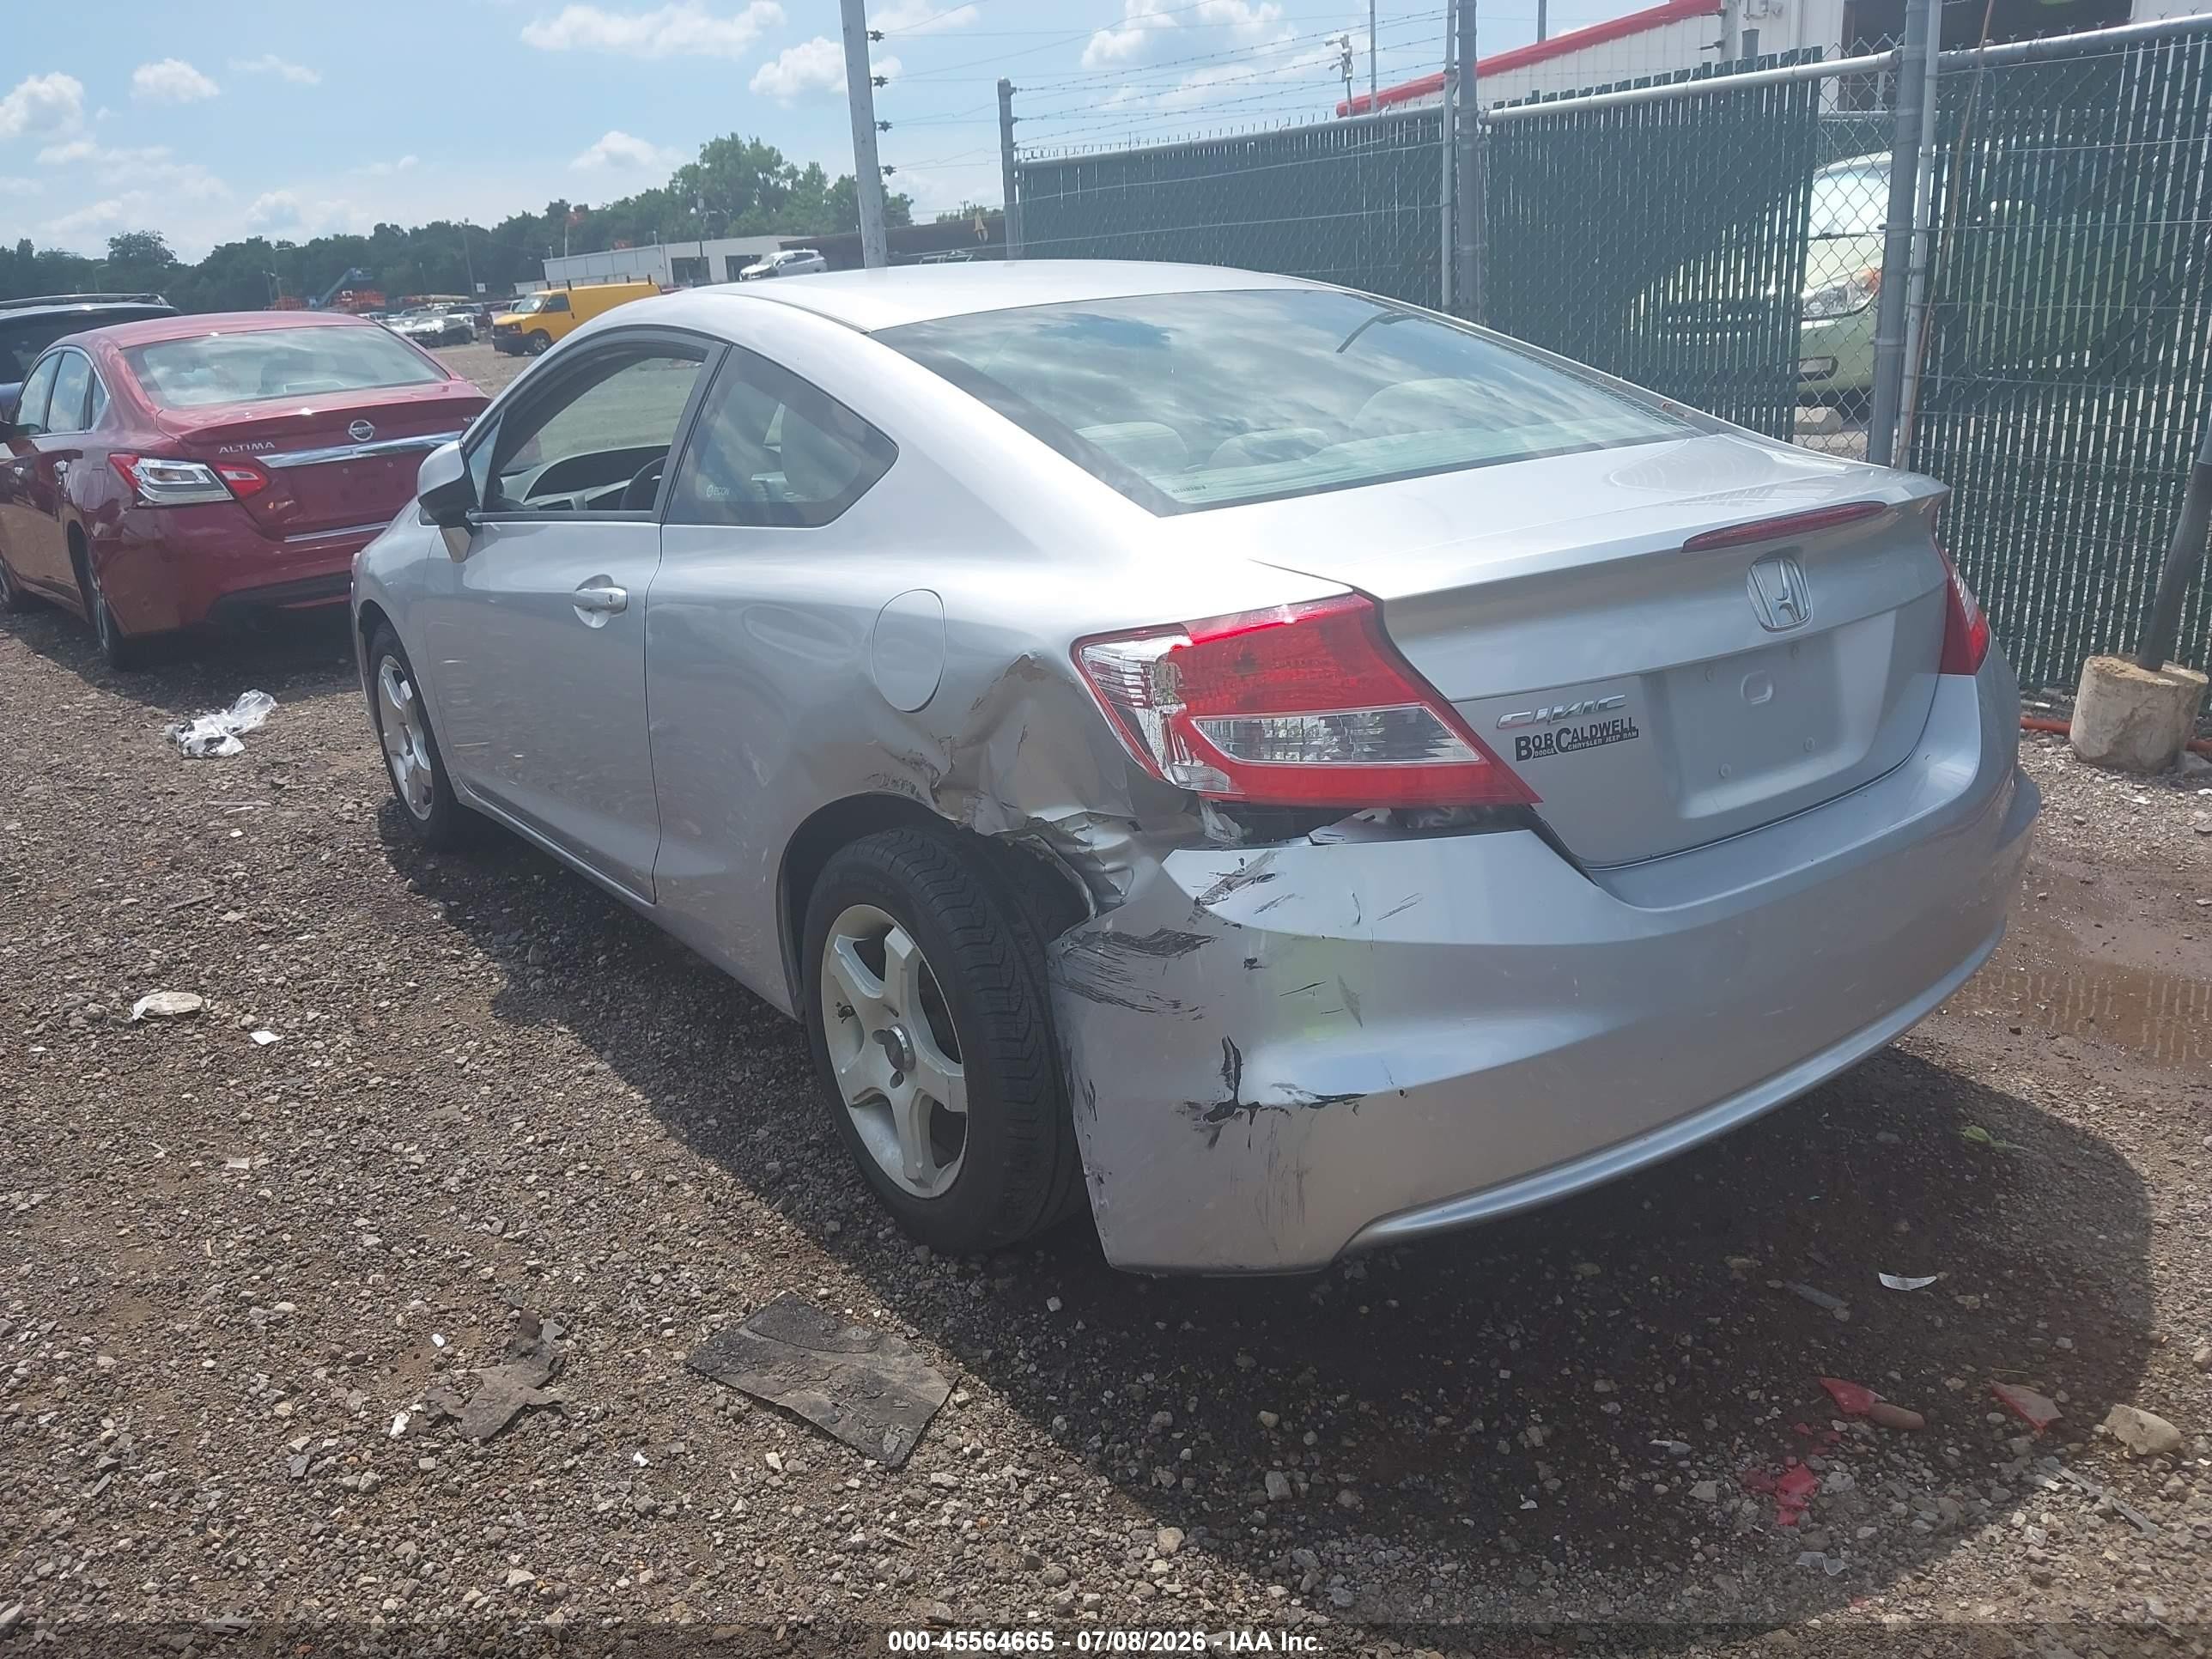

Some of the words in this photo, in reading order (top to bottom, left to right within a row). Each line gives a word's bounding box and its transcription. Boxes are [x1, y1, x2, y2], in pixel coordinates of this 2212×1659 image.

[219, 441, 276, 454] ALTIMA
[1497, 694, 1627, 729] CIVIC
[1515, 732, 1555, 763] BOB
[1555, 716, 1638, 754] CALDWELL
[1534, 748, 1556, 757] DODGE
[1567, 738, 1603, 750] CHRYSLER
[1606, 734, 1620, 744] JEEP
[1623, 731, 1638, 739] RAM
